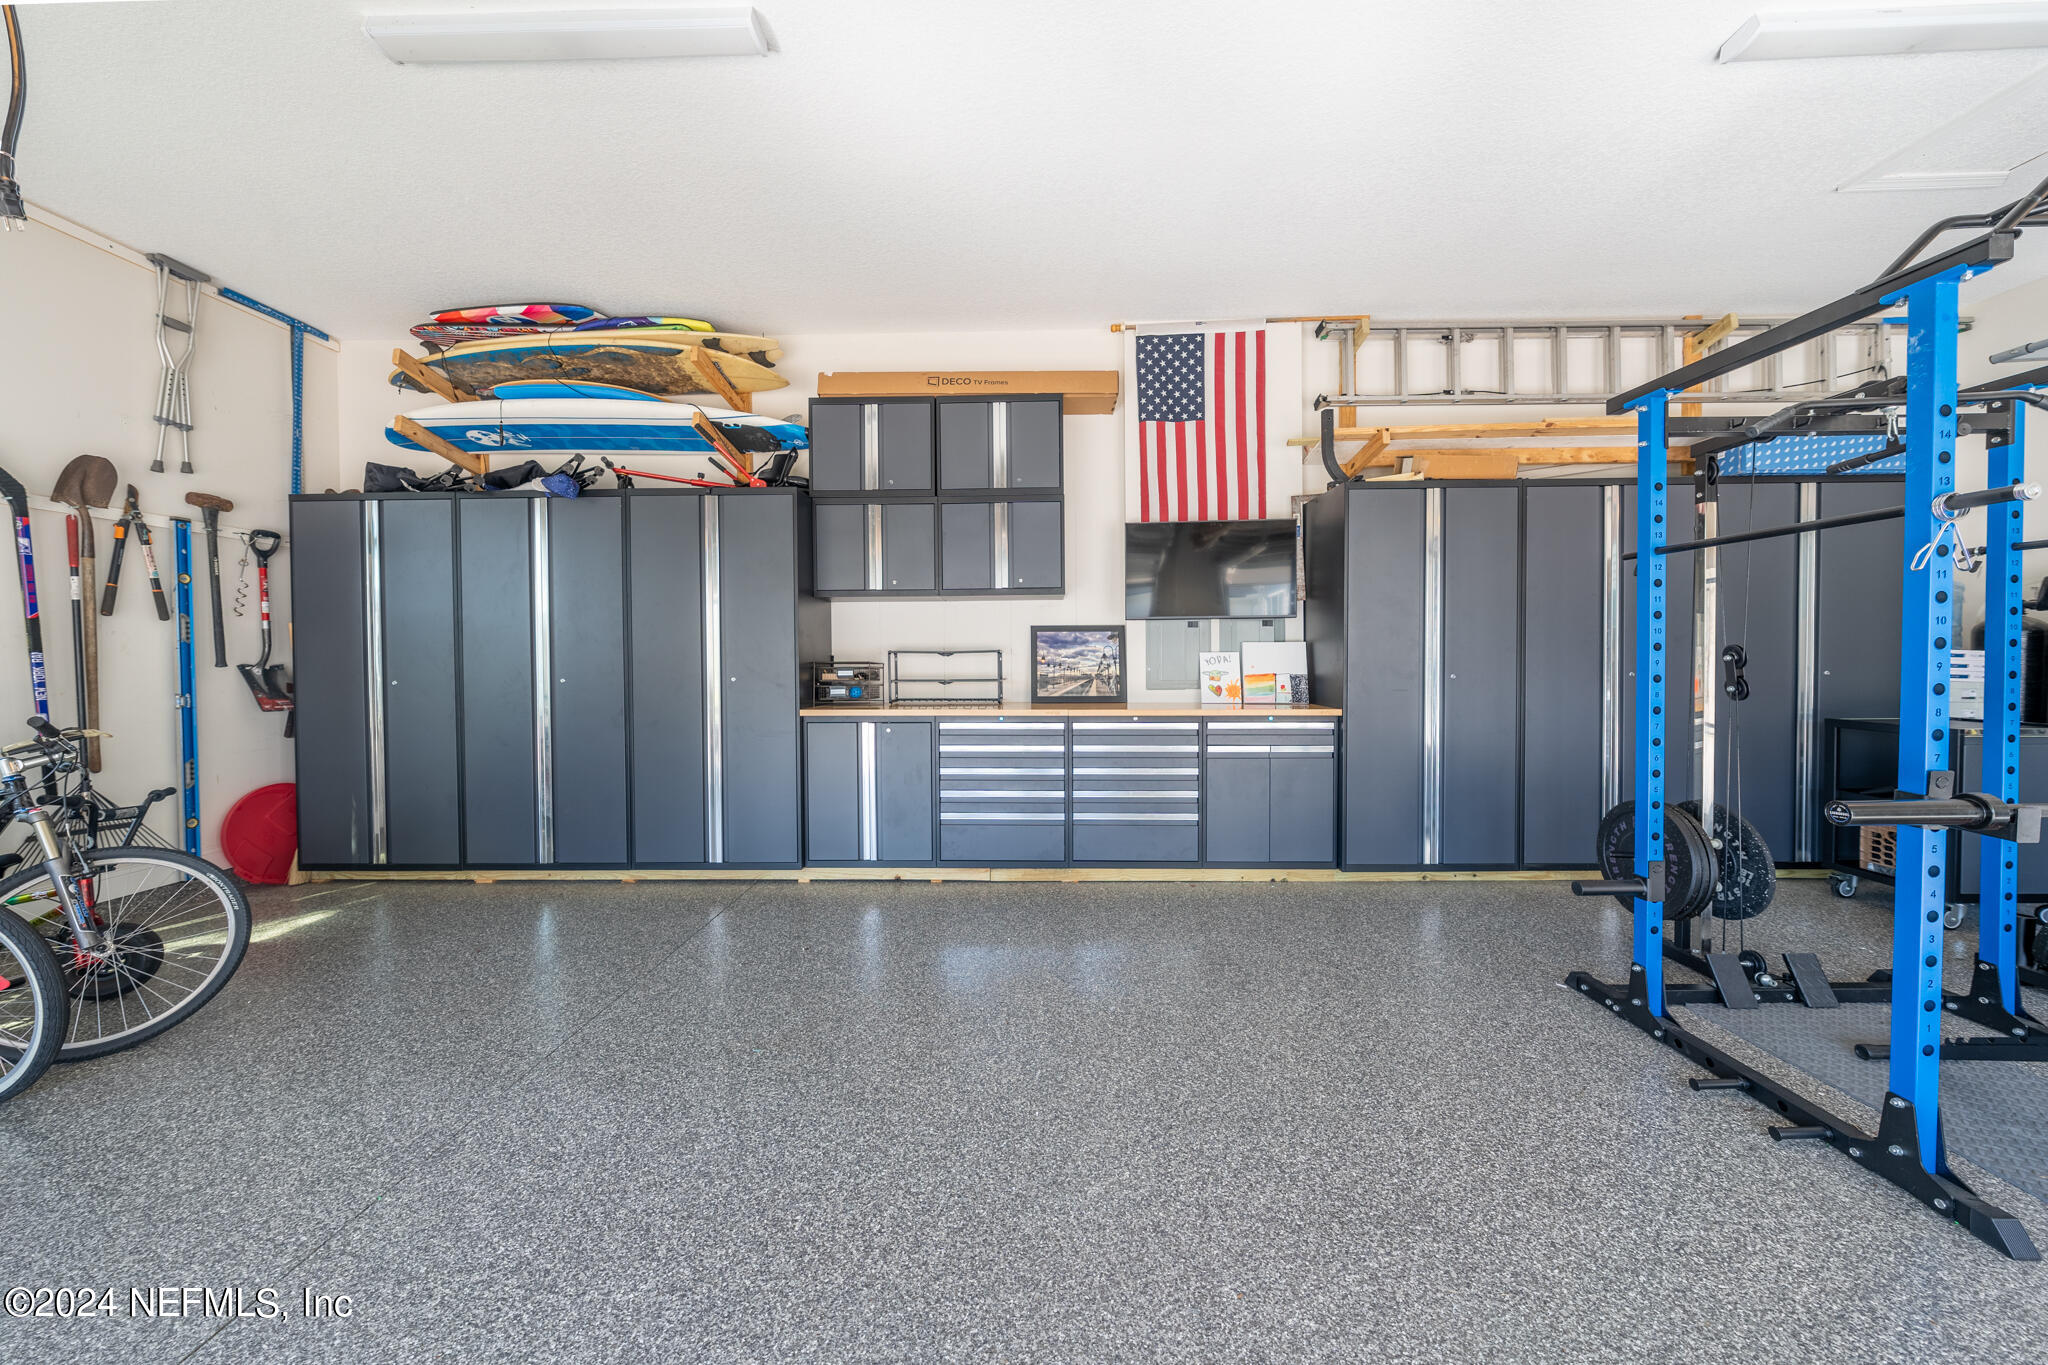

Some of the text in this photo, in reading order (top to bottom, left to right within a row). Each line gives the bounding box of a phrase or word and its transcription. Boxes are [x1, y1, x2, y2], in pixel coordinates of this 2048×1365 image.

[941, 377, 972, 386] DECO
[1940, 429, 1951, 440] 14
[1939, 476, 1950, 486] 13
[1936, 570, 1947, 580] 11
[1936, 616, 1946, 625] 10
[1936, 662, 1942, 672] 9
[32, 666, 46, 684] YORK
[34, 687, 48, 701] NEW
[1935, 708, 1942, 717] 8
[1934, 754, 1940, 763] 7
[1932, 844, 1938, 854] 5
[1930, 889, 1936, 899] 4
[1929, 934, 1935, 944] 3
[1928, 980, 1934, 988] 2
[1928, 1024, 1931, 1033] 1
